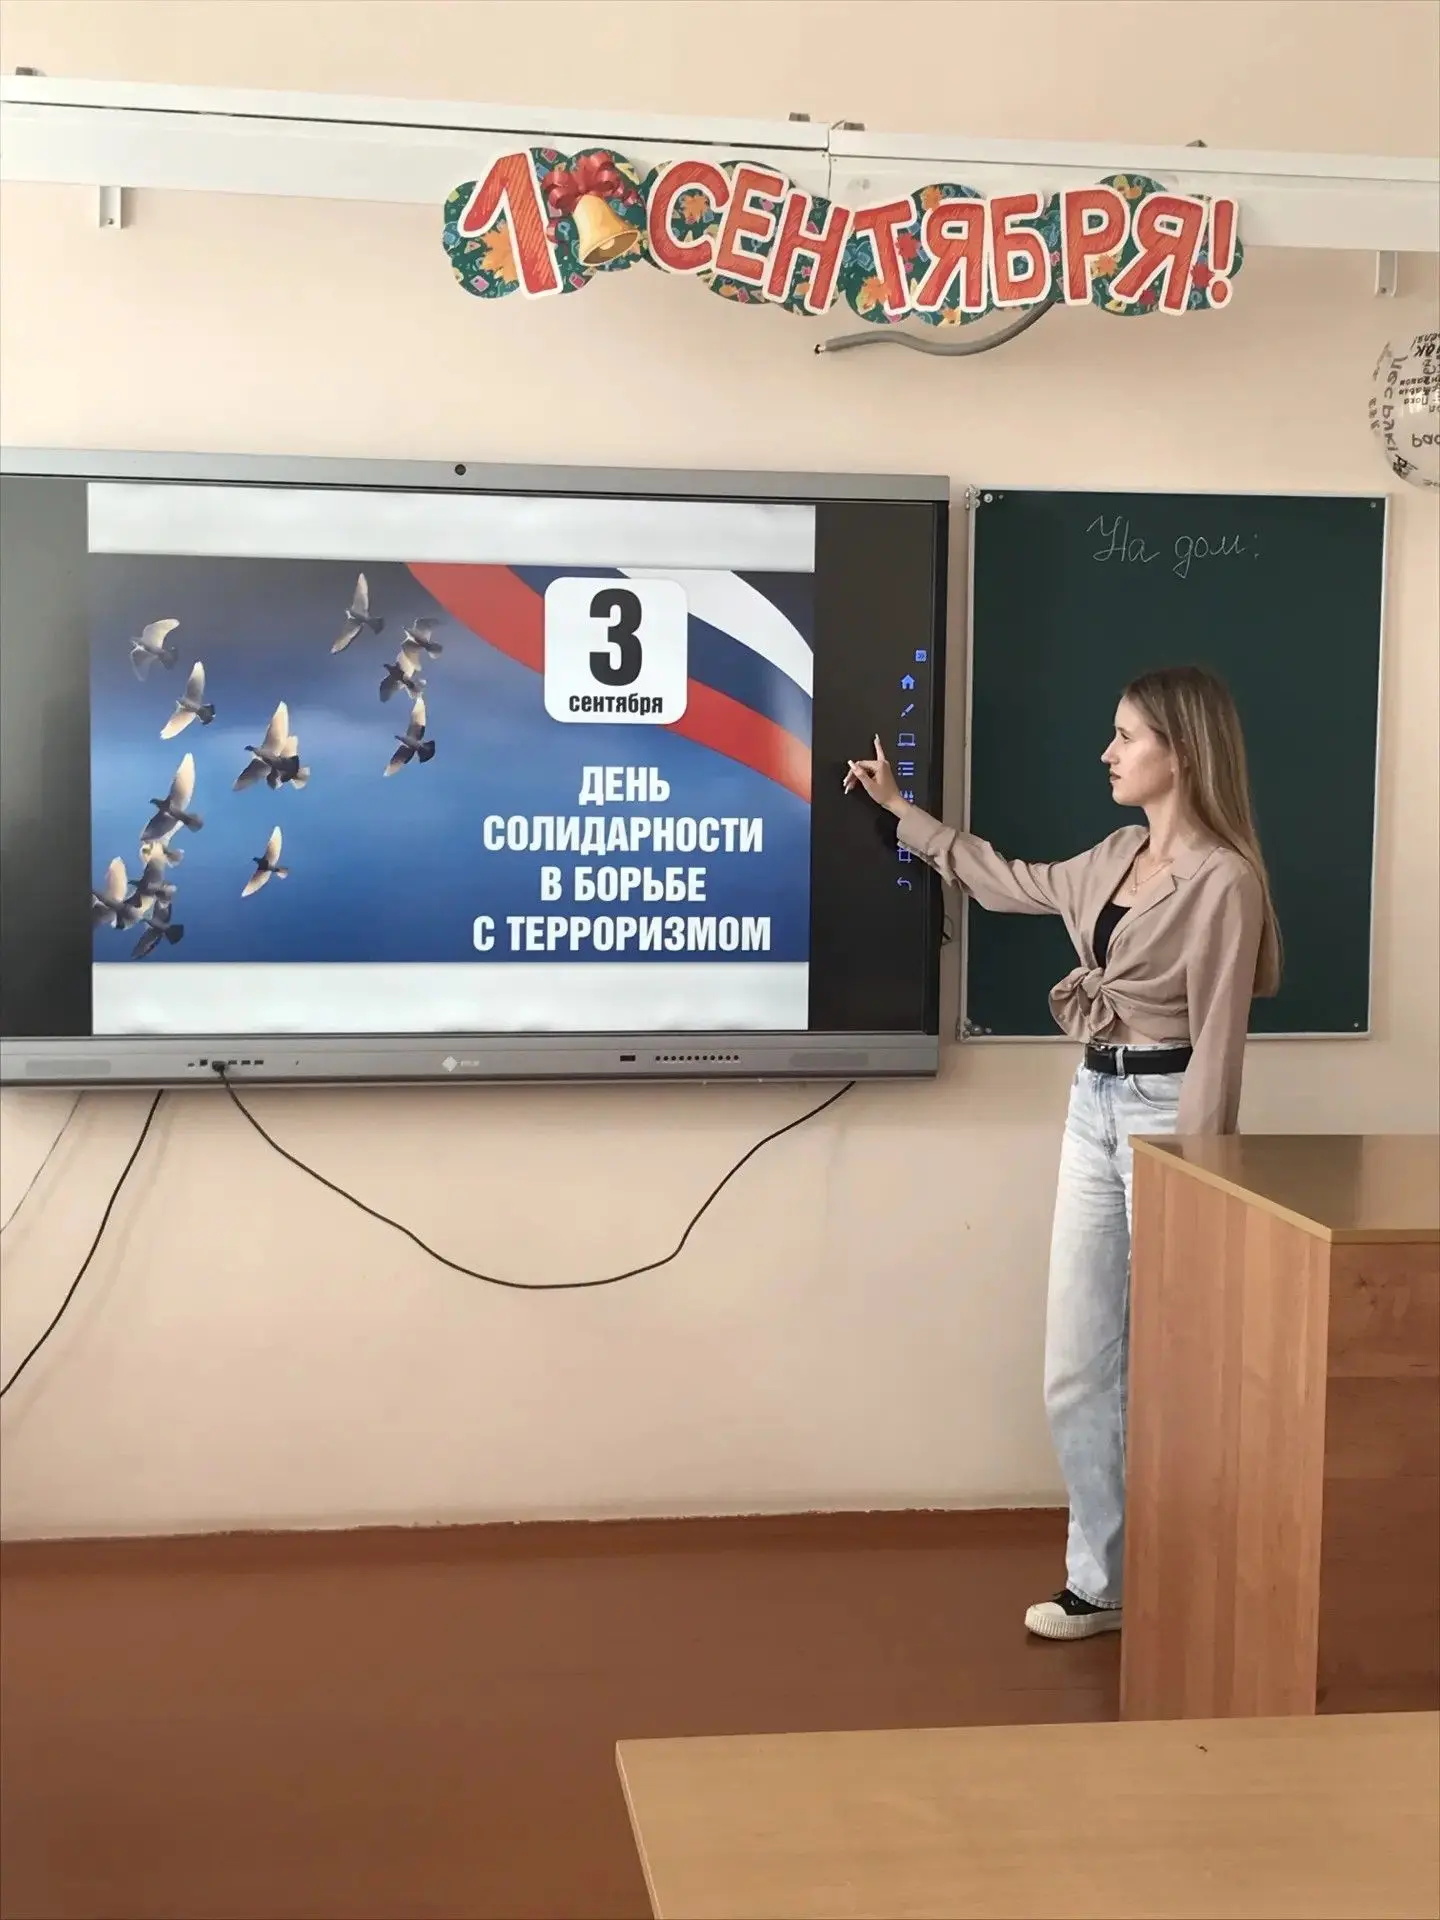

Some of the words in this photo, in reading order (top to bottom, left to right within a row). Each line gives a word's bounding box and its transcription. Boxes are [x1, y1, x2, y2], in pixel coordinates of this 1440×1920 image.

[460, 149, 562, 299] 1
[647, 158, 1241, 317] СЕНТЯБРЯ!
[1086, 515, 1161, 563] На
[1172, 534, 1260, 579] дом:
[588, 587, 643, 687] 3
[568, 691, 664, 715] сентября
[578, 765, 671, 806] ДЕНЬ
[483, 816, 764, 856] СОЛИДАРНОСТИ
[540, 866, 563, 902] В
[574, 866, 707, 902] БОРЬБЕ
[472, 915, 496, 951] С
[506, 916, 772, 952] ТЕРРОРИЗМОМ
